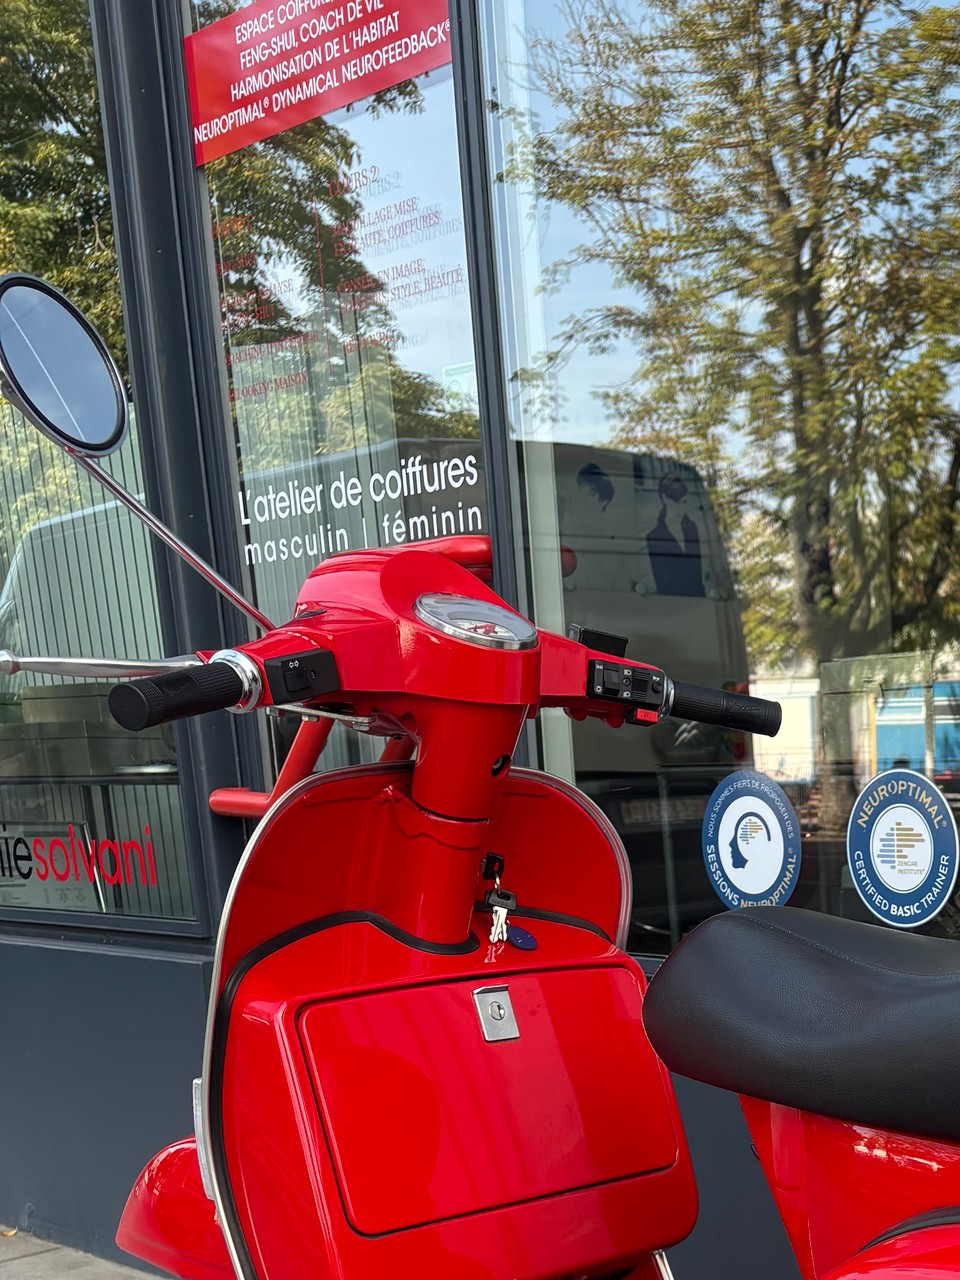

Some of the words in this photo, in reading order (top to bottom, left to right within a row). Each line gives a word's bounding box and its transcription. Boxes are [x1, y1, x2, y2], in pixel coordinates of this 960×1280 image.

[235, 9, 275, 44] ESPACE
[300, 6, 345, 43] COACH
[347, 0, 364, 22] DE
[230, 45, 322, 102] HARMONISATION
[324, 37, 341, 62] DE
[272, 68, 340, 112] DYNAMICAL
[238, 479, 323, 526] L'atelier
[330, 471, 362, 509] de
[369, 454, 478, 502] coiffures
[244, 524, 349, 566] masculin
[383, 501, 482, 545] féminin
[707, 812, 718, 838] NOUS
[751, 779, 760, 790] DE
[0, 823, 157, 887] iesolvani
[706, 844, 740, 906] SESSIONS
[854, 850, 889, 911] CERTIFIED
[890, 902, 922, 917] BASIC
[920, 854, 950, 909] TRAINER
